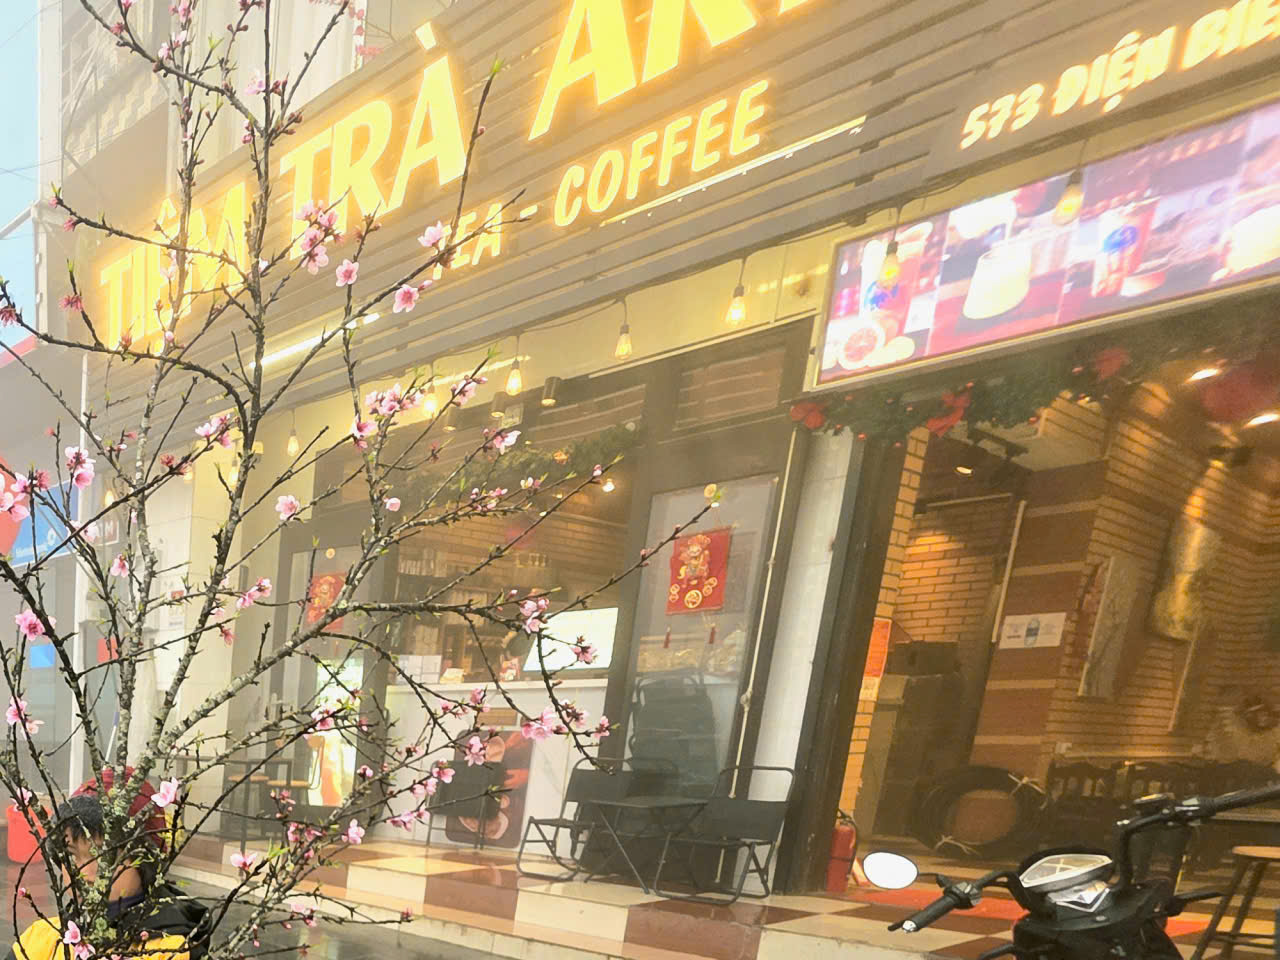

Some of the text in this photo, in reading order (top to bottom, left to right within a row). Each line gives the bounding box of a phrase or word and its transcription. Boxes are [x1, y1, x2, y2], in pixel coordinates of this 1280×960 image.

[279, 21, 468, 261] TRÀ
[554, 79, 769, 227] COFFEE
[960, 83, 1044, 150] 573
[1051, 31, 1177, 114] ĐIỆN
